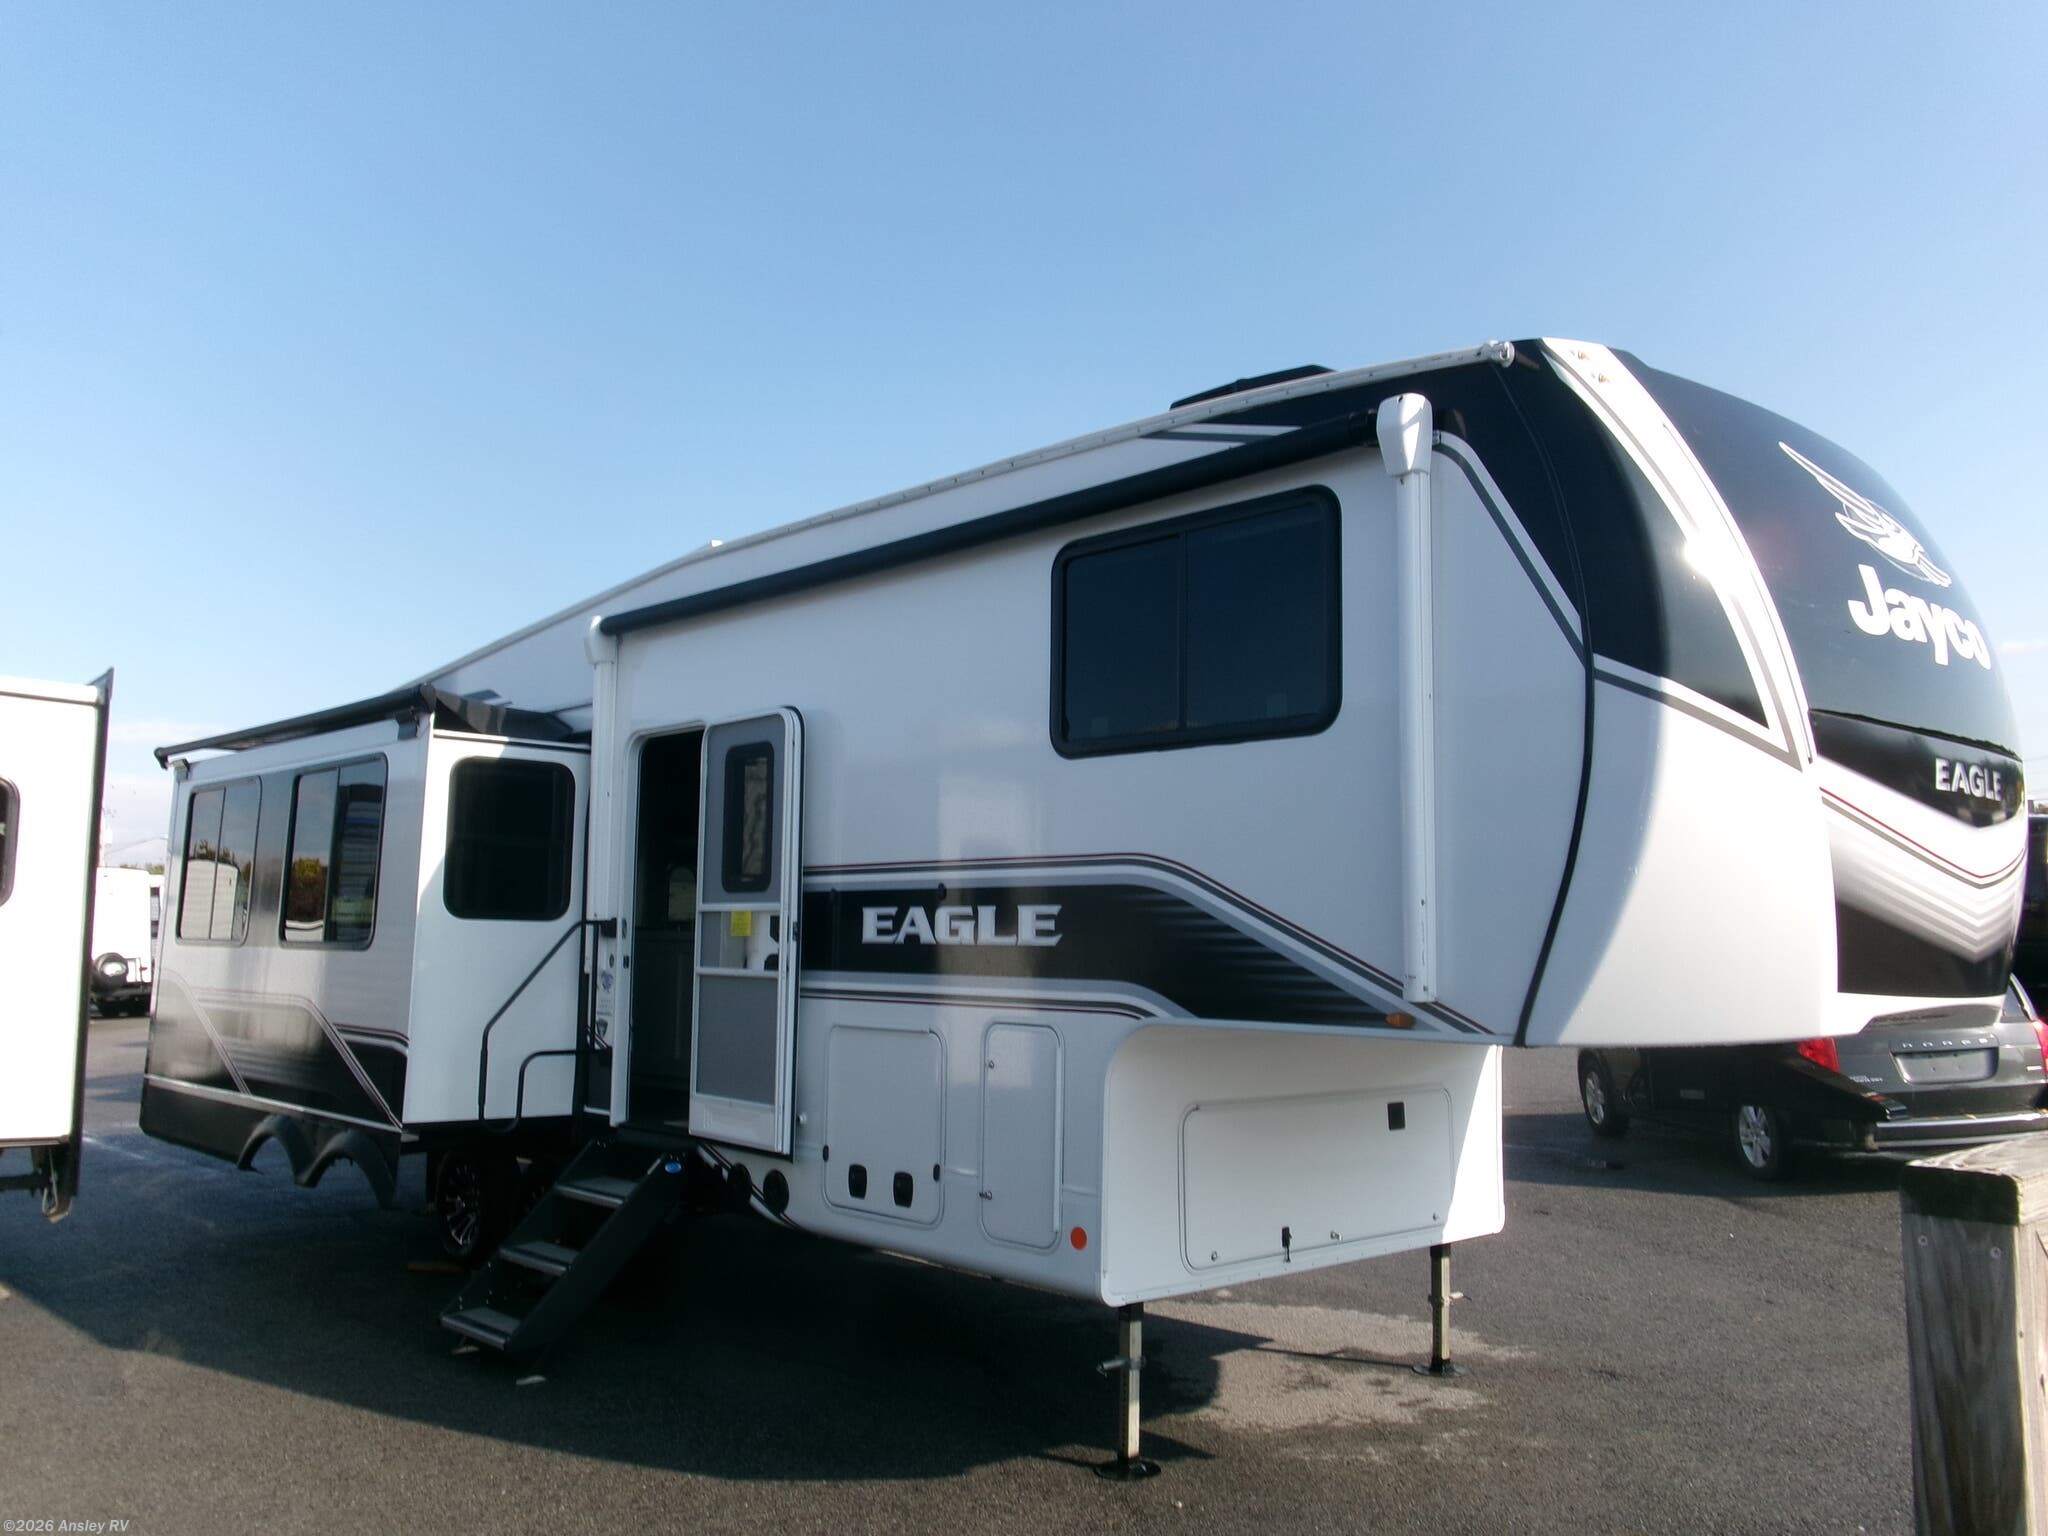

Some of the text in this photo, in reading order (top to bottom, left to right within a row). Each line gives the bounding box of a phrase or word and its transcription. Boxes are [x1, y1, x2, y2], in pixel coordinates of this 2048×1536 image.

[1848, 564, 1992, 670] Jayco
[1935, 757, 2002, 802] EAGLE
[861, 904, 1063, 947] EAGLE
